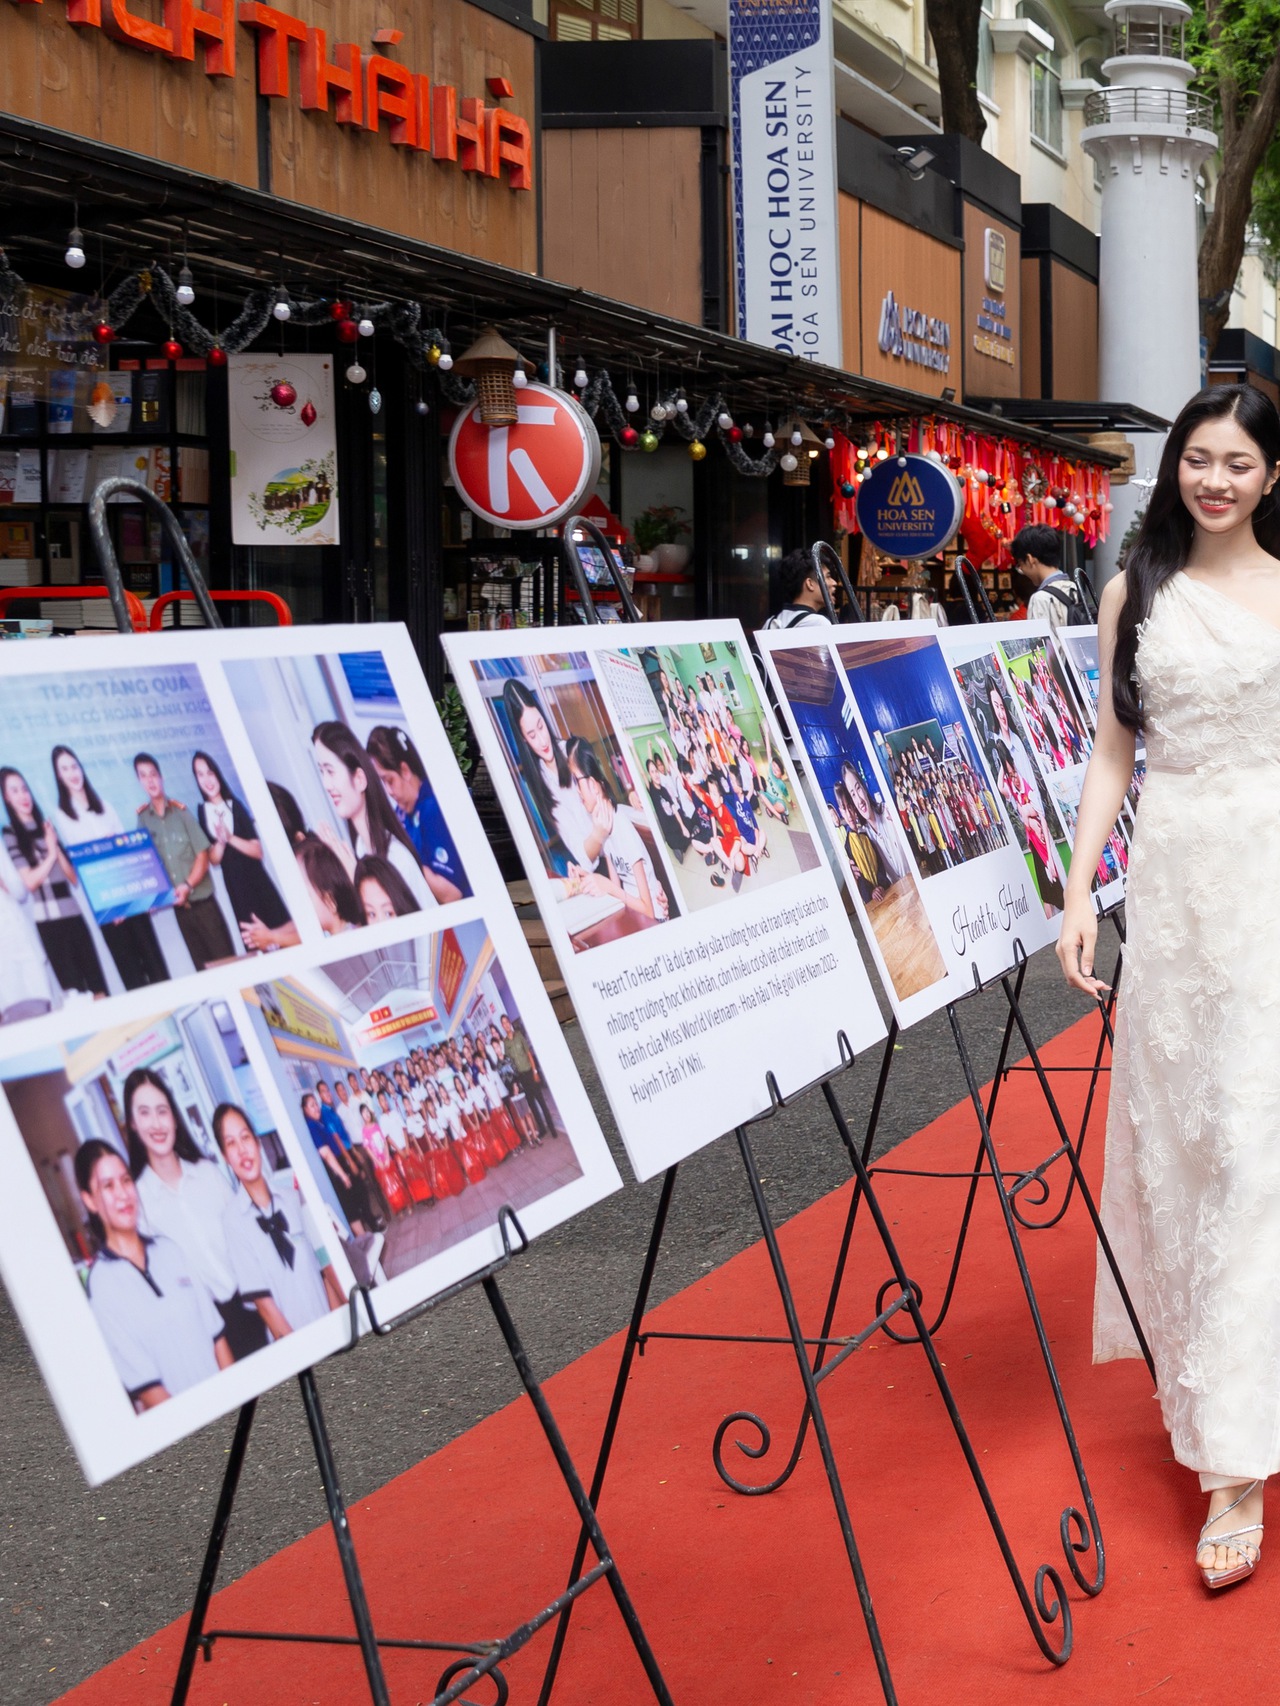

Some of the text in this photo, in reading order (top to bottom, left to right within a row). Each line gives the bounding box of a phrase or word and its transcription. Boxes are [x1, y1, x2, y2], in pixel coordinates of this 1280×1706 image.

[238, 1, 431, 152] THÁI
[432, 77, 531, 190] HÀ
[765, 81, 788, 136] SEN
[766, 147, 790, 218] HOA
[795, 66, 819, 360] HOA SEN UNIVERSITY
[768, 228, 799, 301] HỌC
[877, 509, 935, 521] HOA SEN
[877, 522, 935, 531] UNIVERSITY
[623, 970, 638, 989] To
[662, 954, 675, 974] là
[695, 941, 711, 962] xây
[721, 928, 749, 951] trường
[745, 923, 761, 942] học
[767, 914, 782, 932] trao
[817, 894, 829, 911] cho
[951, 904, 988, 956] Heart
[998, 883, 1029, 931] Head
[606, 1011, 640, 1036] những
[635, 998, 668, 1023] trường
[662, 991, 683, 1012] học
[679, 980, 698, 1004] khó
[718, 967, 732, 987] còn
[618, 1041, 648, 1070] thành
[646, 1035, 664, 1057] của
[660, 1028, 683, 1049] Miss
[679, 1011, 707, 1040] World
[704, 1002, 739, 1028] Vietnam
[739, 993, 757, 1012] Hoa
[754, 985, 771, 1007] hậu
[805, 962, 823, 982] Nam
[820, 953, 837, 973] 2023
[629, 1052, 706, 1104] Huỳnh Trần Ý Nhi.
